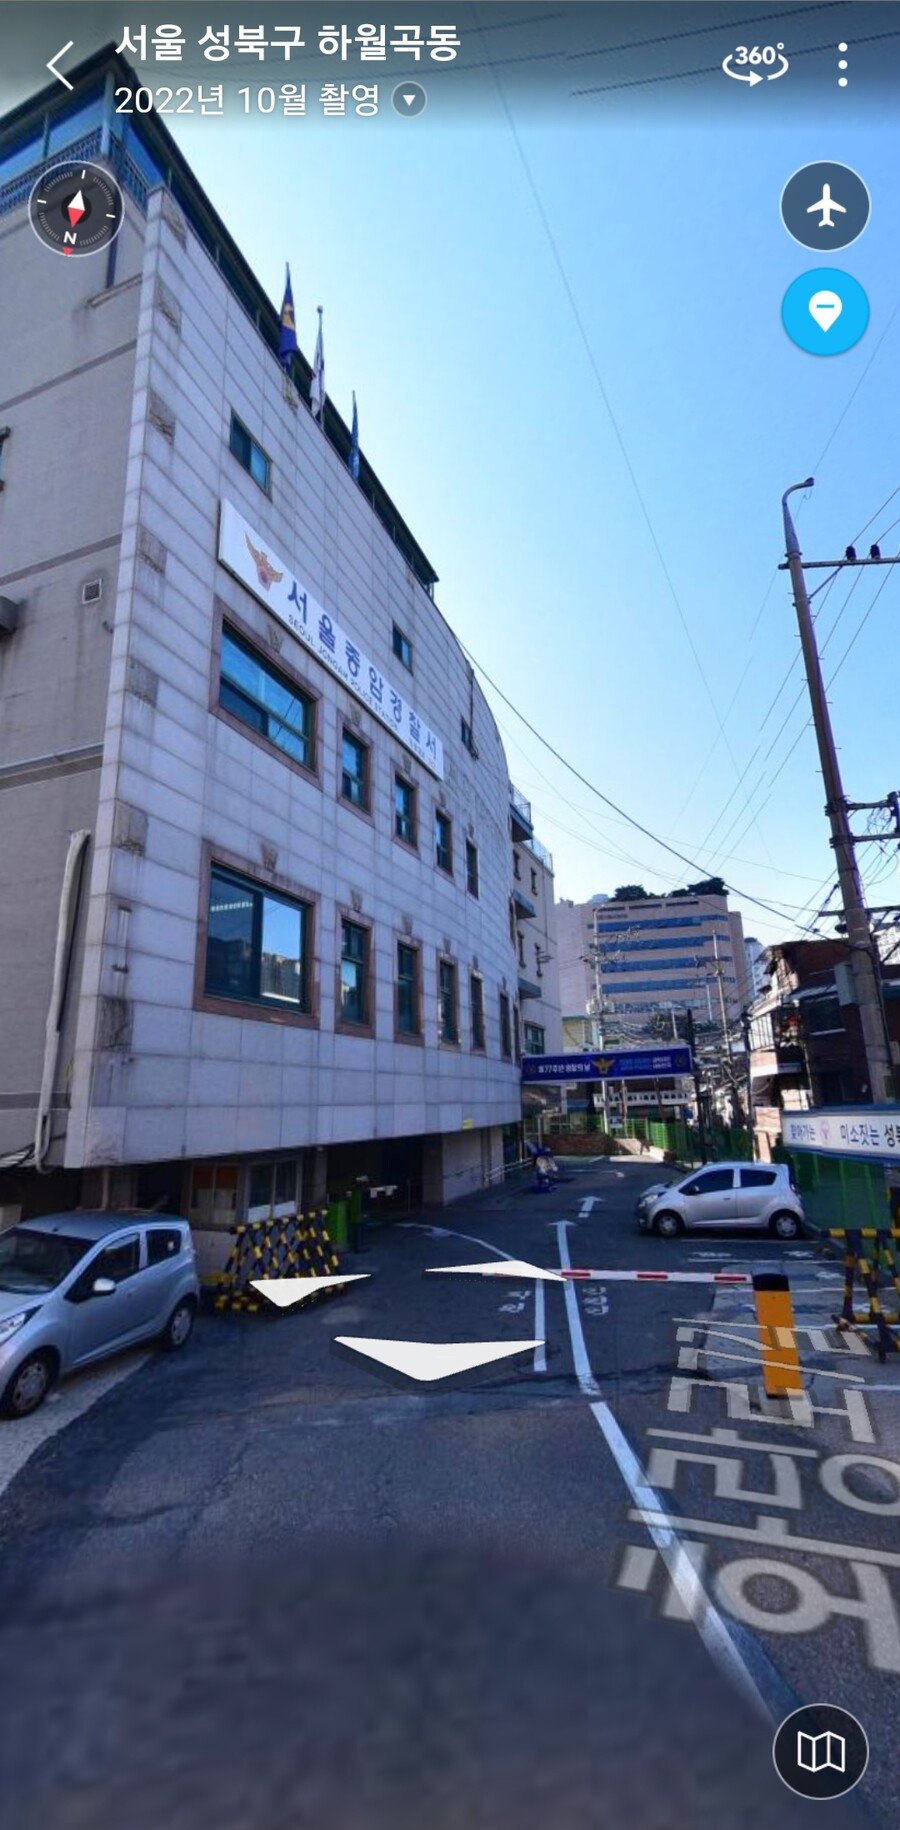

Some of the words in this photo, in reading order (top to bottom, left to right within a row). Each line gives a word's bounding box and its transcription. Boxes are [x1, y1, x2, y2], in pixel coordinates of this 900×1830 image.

[287, 580, 438, 760] 서울종암경찰서
[288, 614, 316, 647] SEOUL
[317, 646, 349, 682] JONGAM
[350, 677, 373, 707] POLICE
[373, 702, 399, 731] STATION
[839, 1123, 880, 1146] 미소짓는
